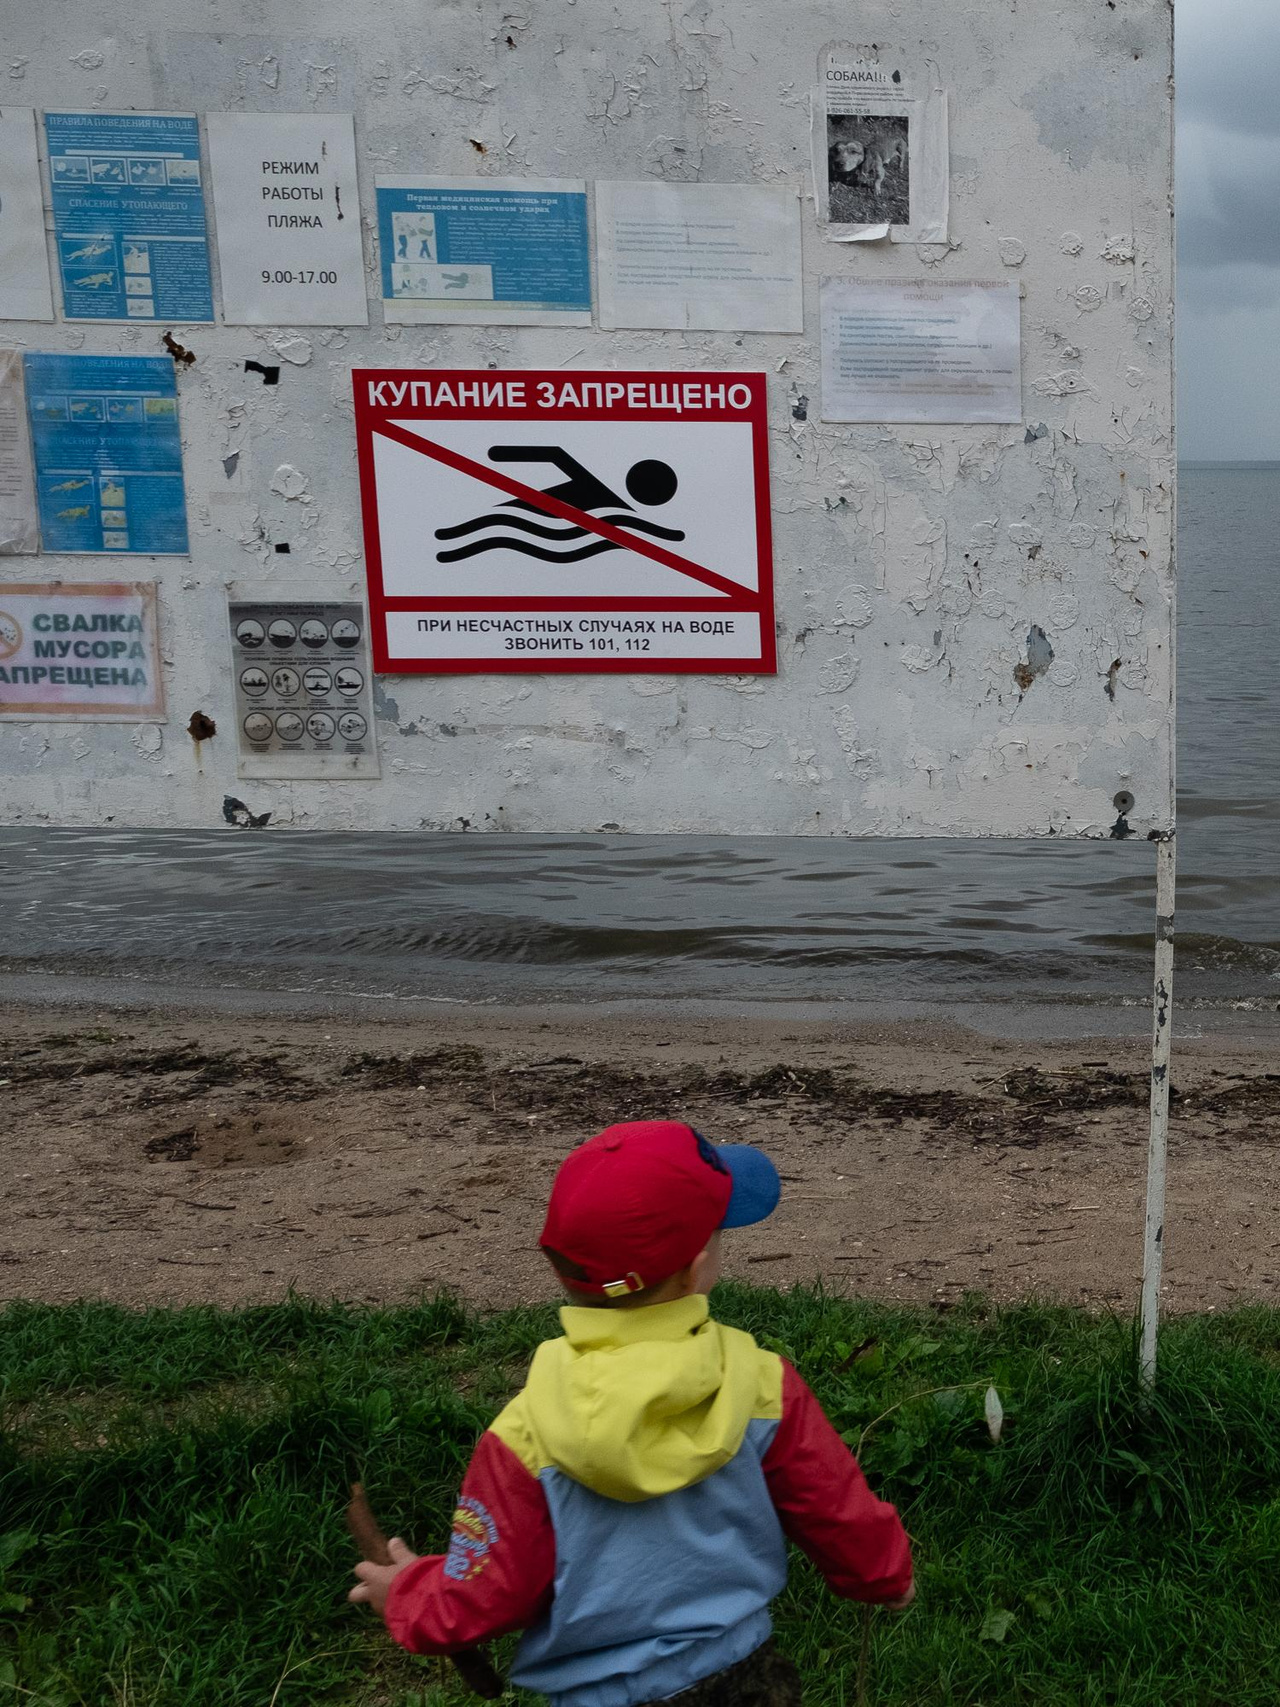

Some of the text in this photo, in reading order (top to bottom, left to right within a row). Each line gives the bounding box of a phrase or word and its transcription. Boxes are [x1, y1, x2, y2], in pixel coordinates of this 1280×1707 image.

[49, 116, 193, 130] ПРАВИЛА ПОВЕДЕНИЯ НА ВОДЕ
[262, 161, 319, 175] РЕЖИМ
[262, 186, 323, 200] РАБОТЫ
[407, 194, 558, 206] Первая медицинская помощь при
[69, 199, 188, 211] СПАСЕНИЕ УТОПАЮЩЕГО
[519, 206, 550, 214] ударах
[267, 215, 323, 228] ПЛЯЖА
[261, 270, 338, 284] 9.00-17.00
[903, 293, 944, 302] помощи
[367, 380, 752, 414] КУПАНИЕ ЗАПРЕЩЕНО
[32, 613, 144, 632] СВАЛКА
[417, 619, 735, 635] ПРИ НЕСЧАСТНЫХ СЛУЧАЯХ НА ВОДЕ
[33, 640, 146, 659] МУСОРА
[504, 637, 650, 652] ЗВОНИТЬ 101, 112
[0, 665, 148, 688] АПРЕЩЕНА
